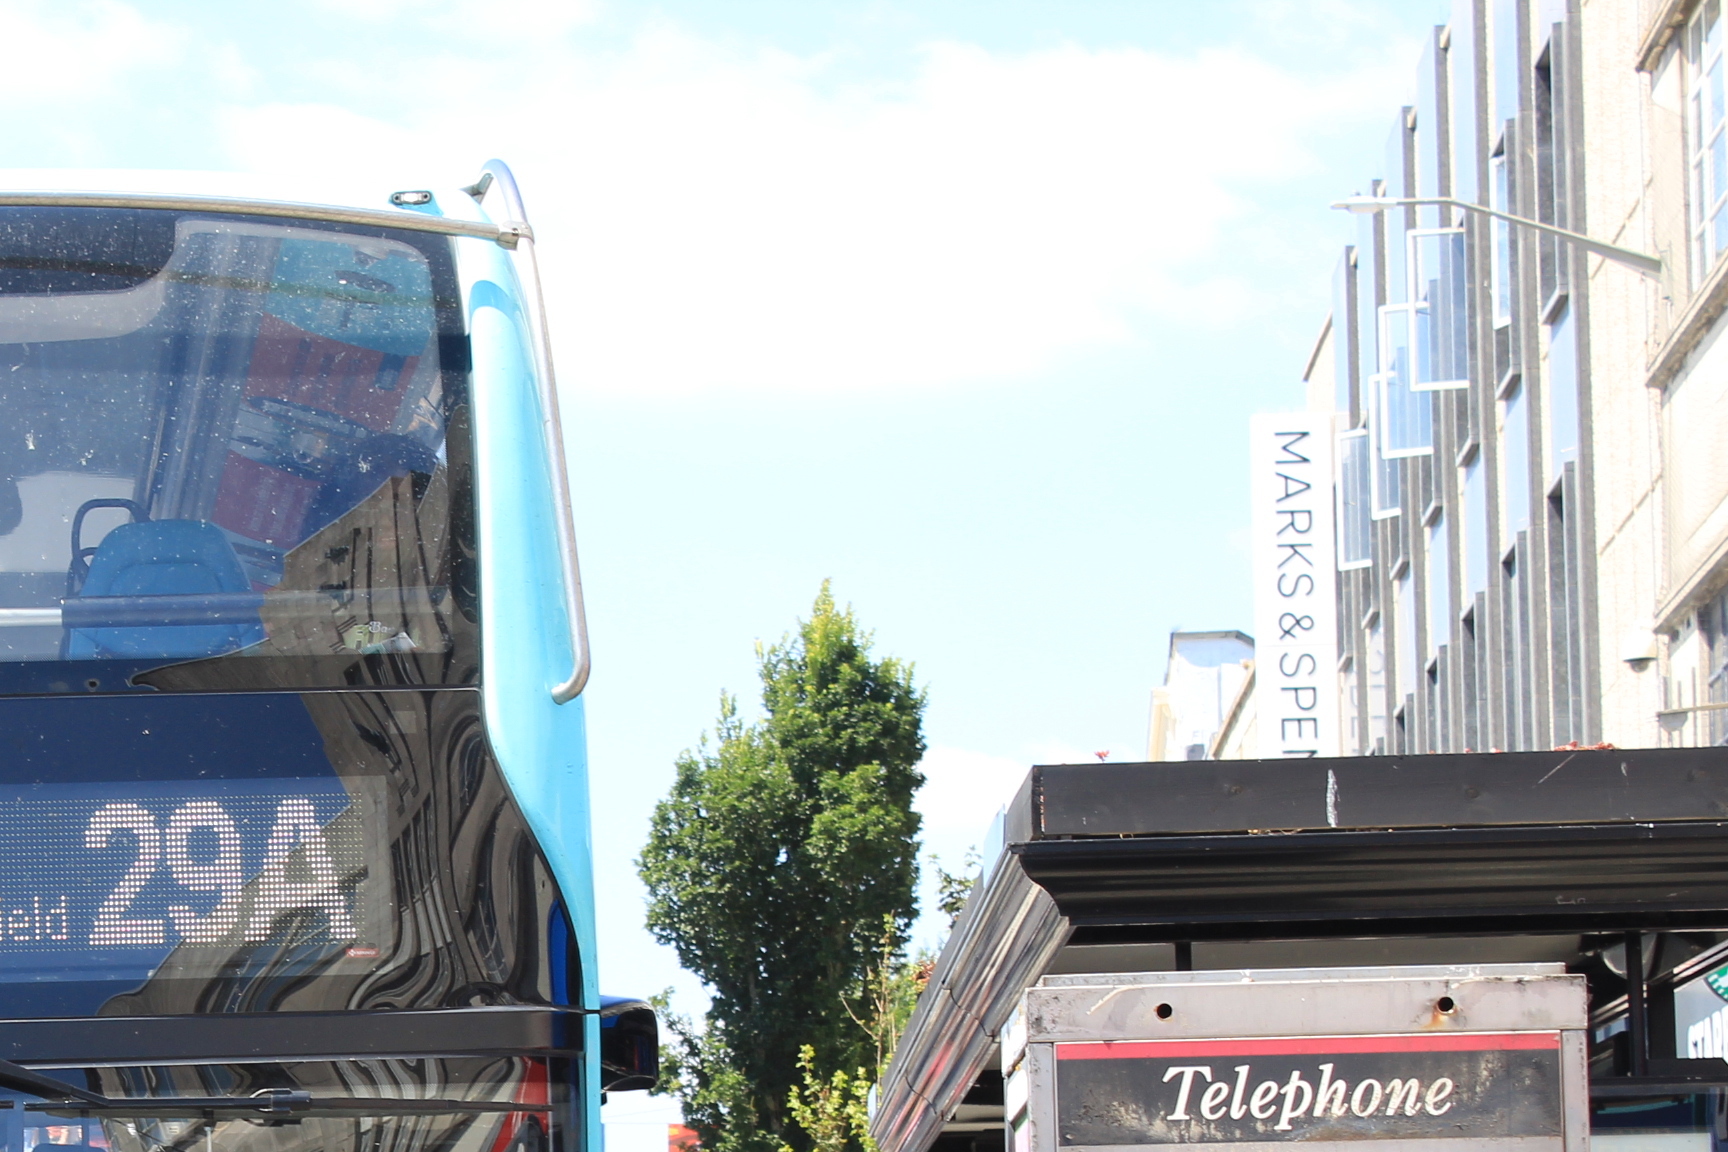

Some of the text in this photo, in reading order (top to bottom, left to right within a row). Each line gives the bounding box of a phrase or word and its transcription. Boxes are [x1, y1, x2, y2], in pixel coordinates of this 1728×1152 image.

[1273, 431, 1315, 598] MARKS
[1278, 611, 1315, 641] &
[85, 798, 358, 946] 29A
[1161, 1062, 1455, 1131] Telephone
